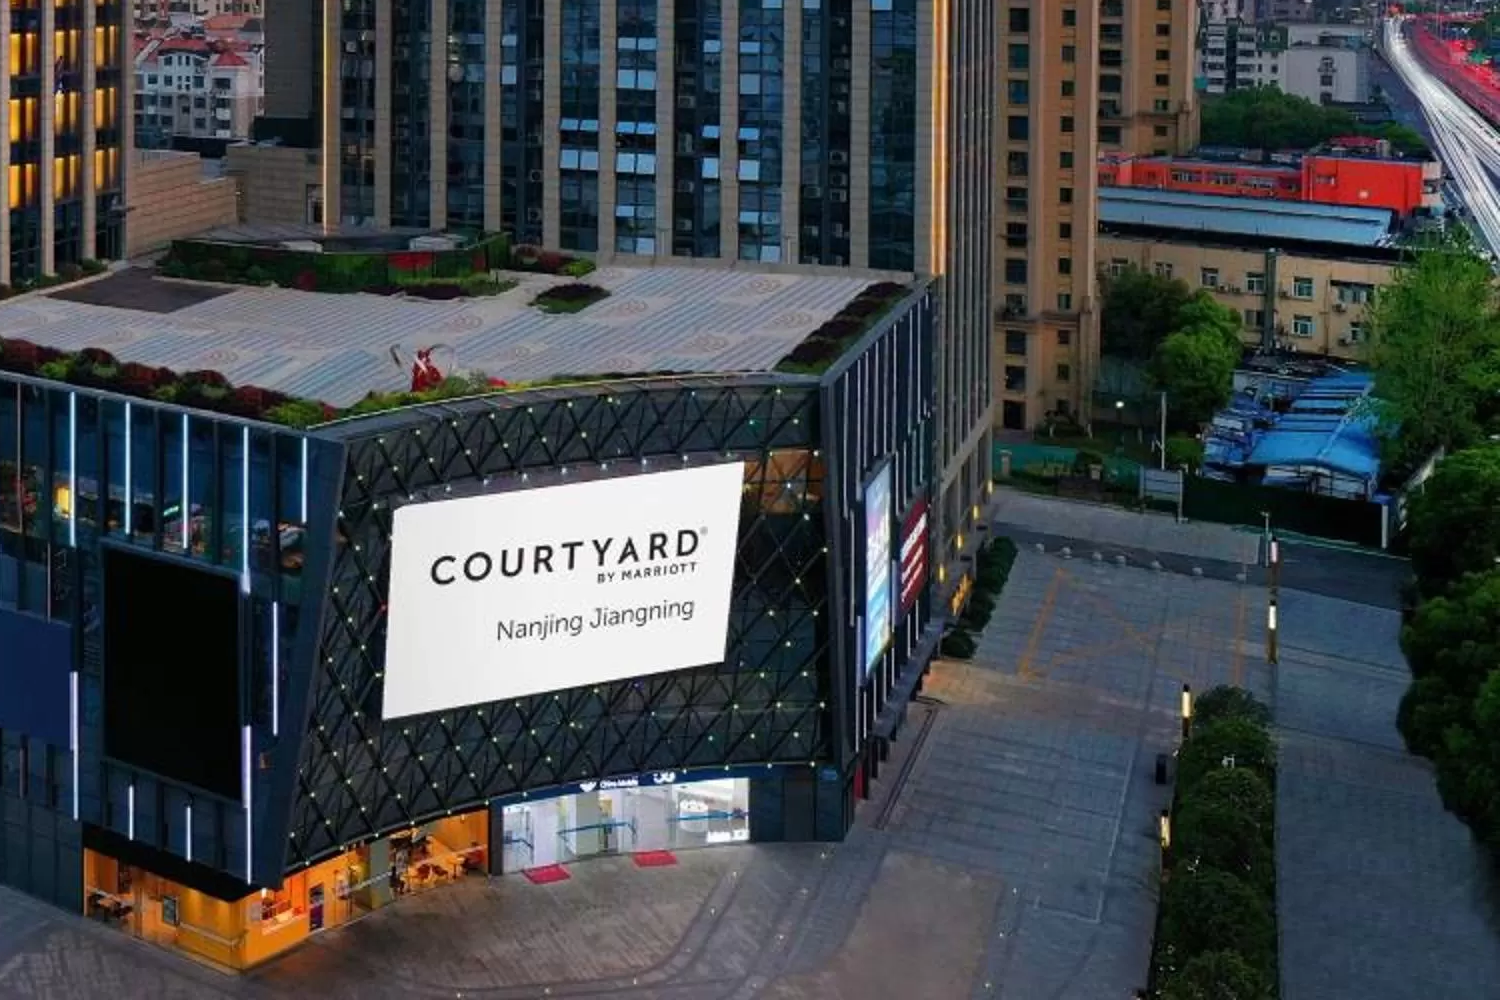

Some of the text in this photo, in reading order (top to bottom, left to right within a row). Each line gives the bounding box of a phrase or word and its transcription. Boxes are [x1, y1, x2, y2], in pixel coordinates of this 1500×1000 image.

[430, 529, 700, 585] COURTYARD
[597, 561, 699, 584] BY MARRIOTT
[496, 600, 695, 641] Nanjing Jiangning
